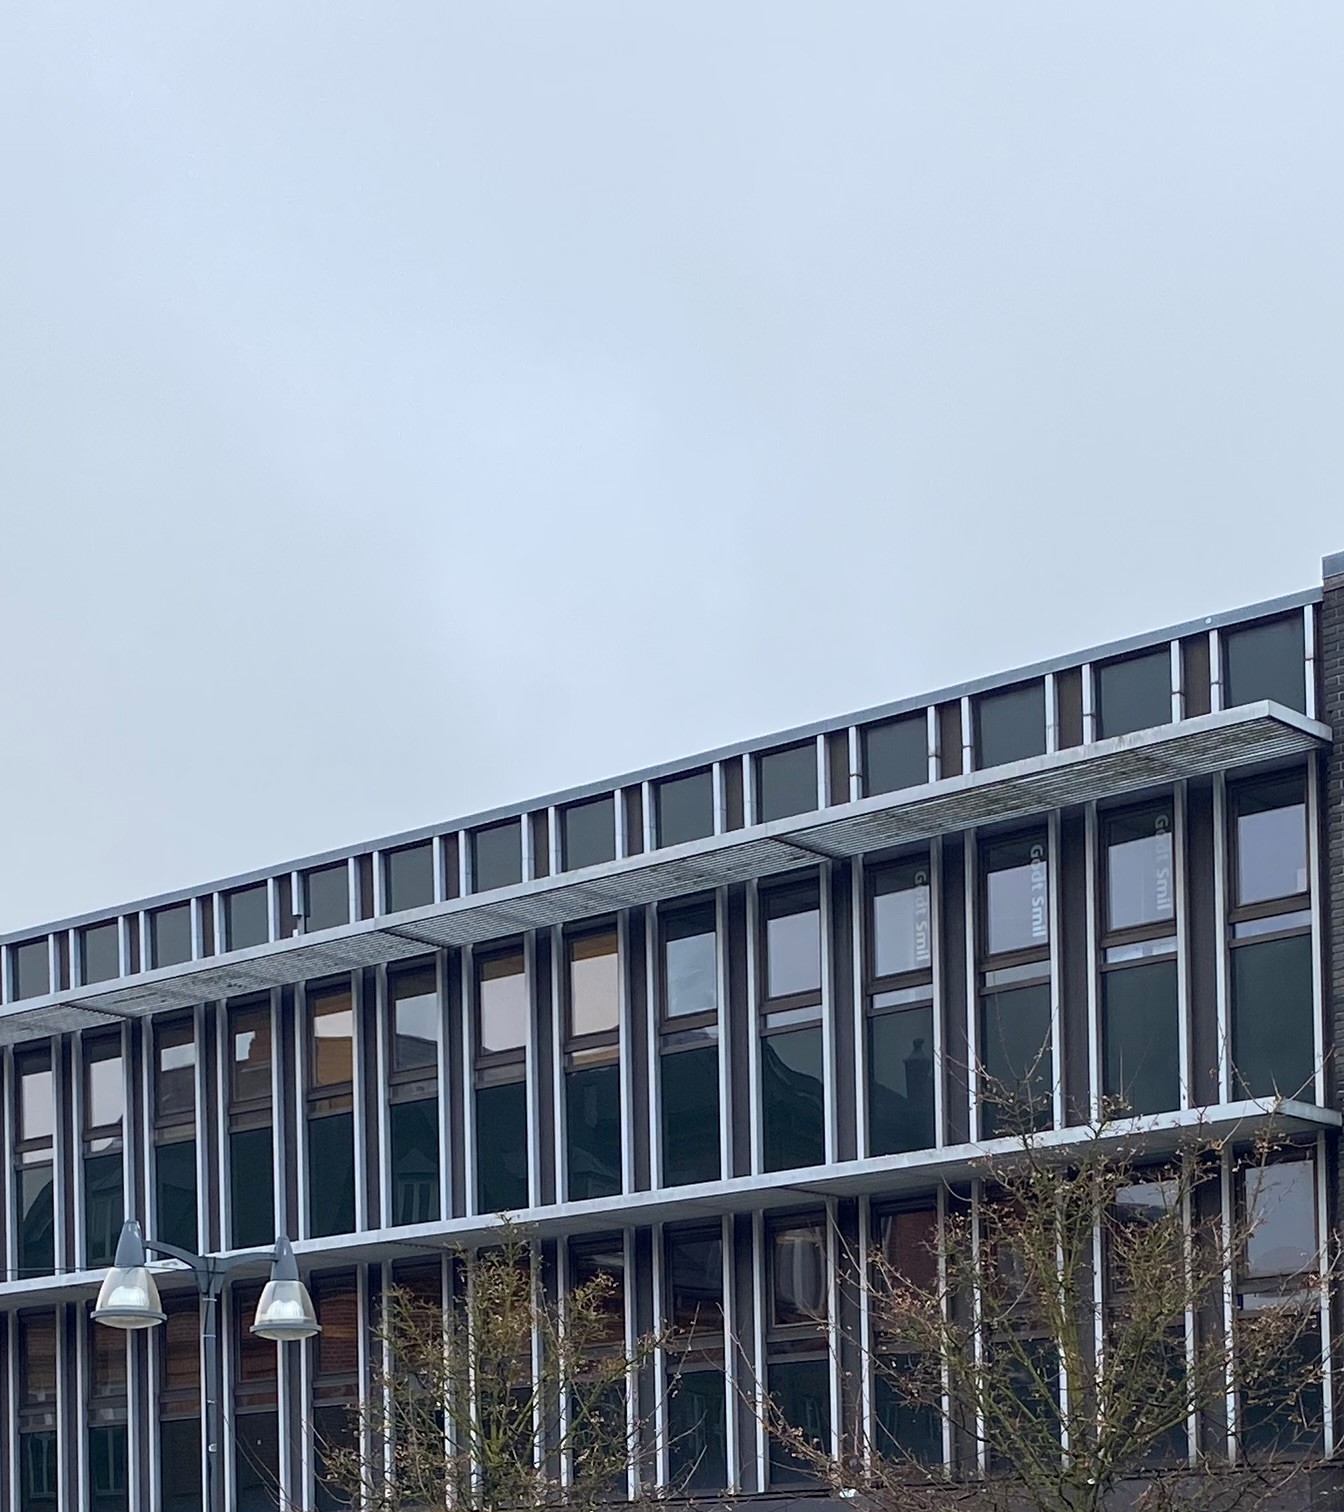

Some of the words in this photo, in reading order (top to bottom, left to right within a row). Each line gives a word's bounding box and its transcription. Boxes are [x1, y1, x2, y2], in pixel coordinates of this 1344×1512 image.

[1031, 844, 1046, 892] Godt
[1157, 867, 1171, 910] Smil
[1032, 896, 1046, 937] Smil
[916, 921, 929, 961] Smil
